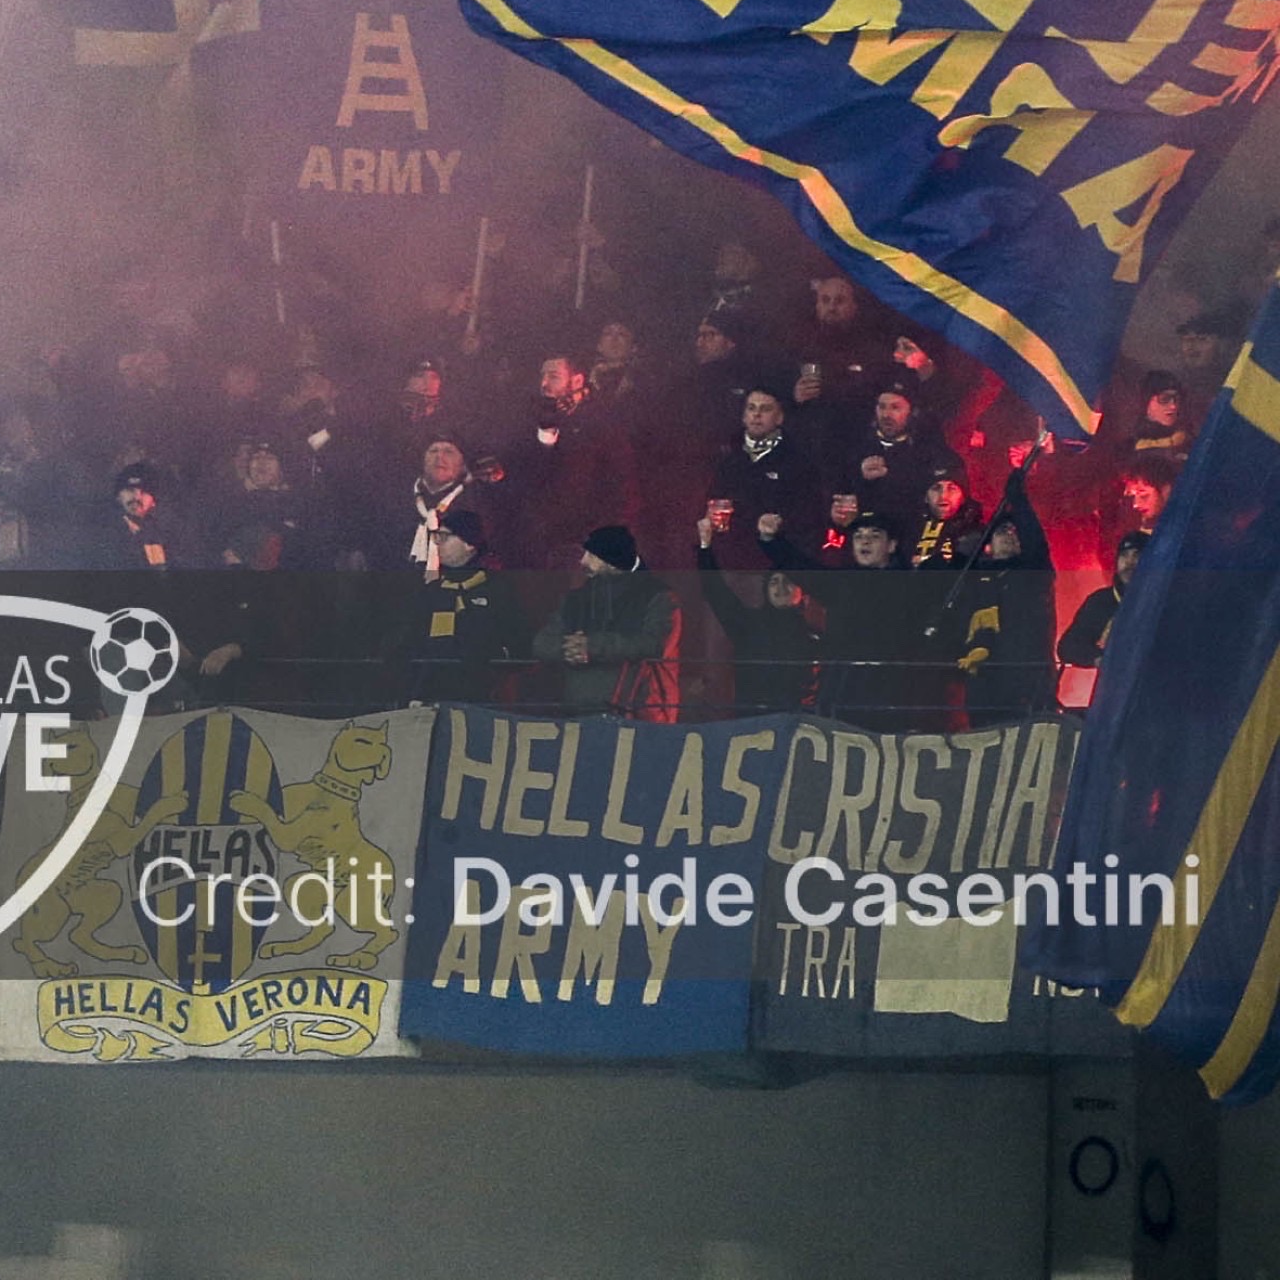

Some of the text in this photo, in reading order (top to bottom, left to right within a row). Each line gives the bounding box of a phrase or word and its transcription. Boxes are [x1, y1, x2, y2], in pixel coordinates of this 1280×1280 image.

[297, 145, 462, 195] ARMY
[441, 708, 775, 847] HELLAS
[768, 721, 1081, 874] CRISTIA
[432, 878, 689, 1006] ARMY
[777, 922, 856, 999] TRA
[54, 975, 372, 1033] HELLAS VERONA
